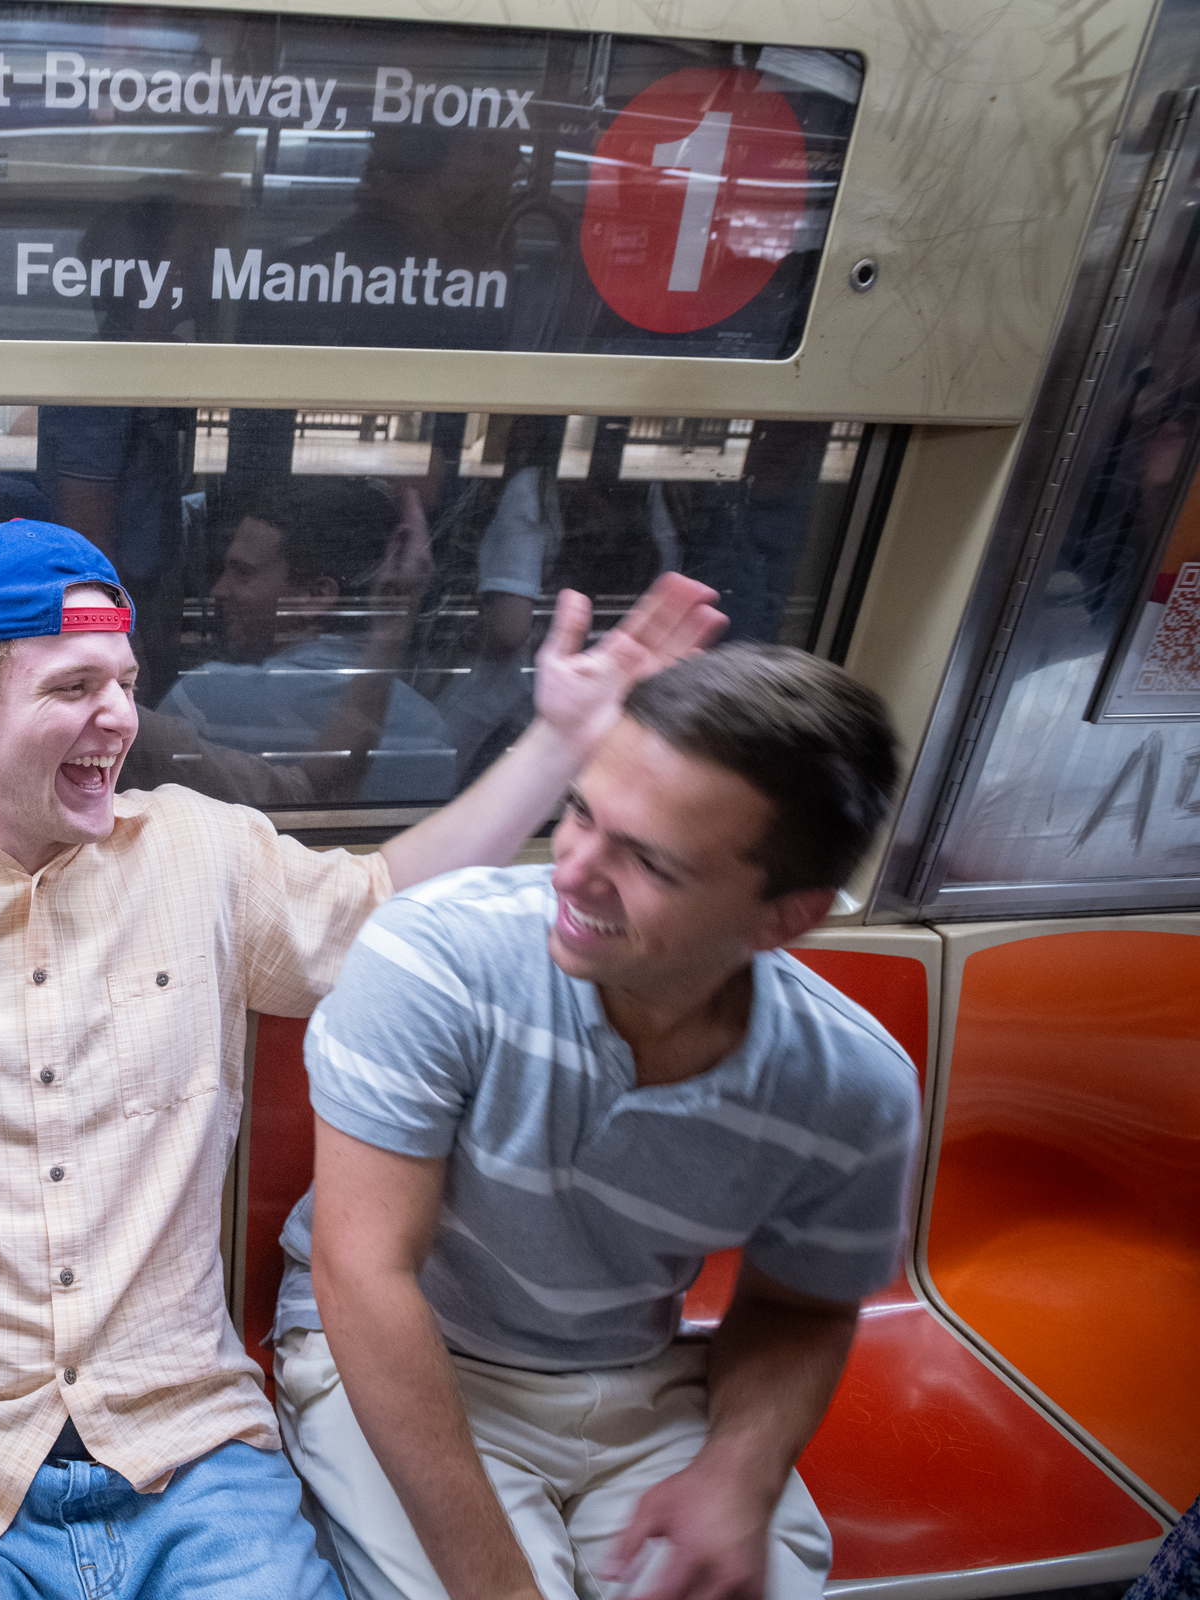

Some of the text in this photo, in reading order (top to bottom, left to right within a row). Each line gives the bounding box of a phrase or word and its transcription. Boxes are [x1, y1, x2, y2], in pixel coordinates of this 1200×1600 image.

[372, 66, 535, 129] Bronx
[652, 112, 731, 291] 1
[16, 243, 183, 310] Ferry,
[211, 248, 507, 308] Manhattan
